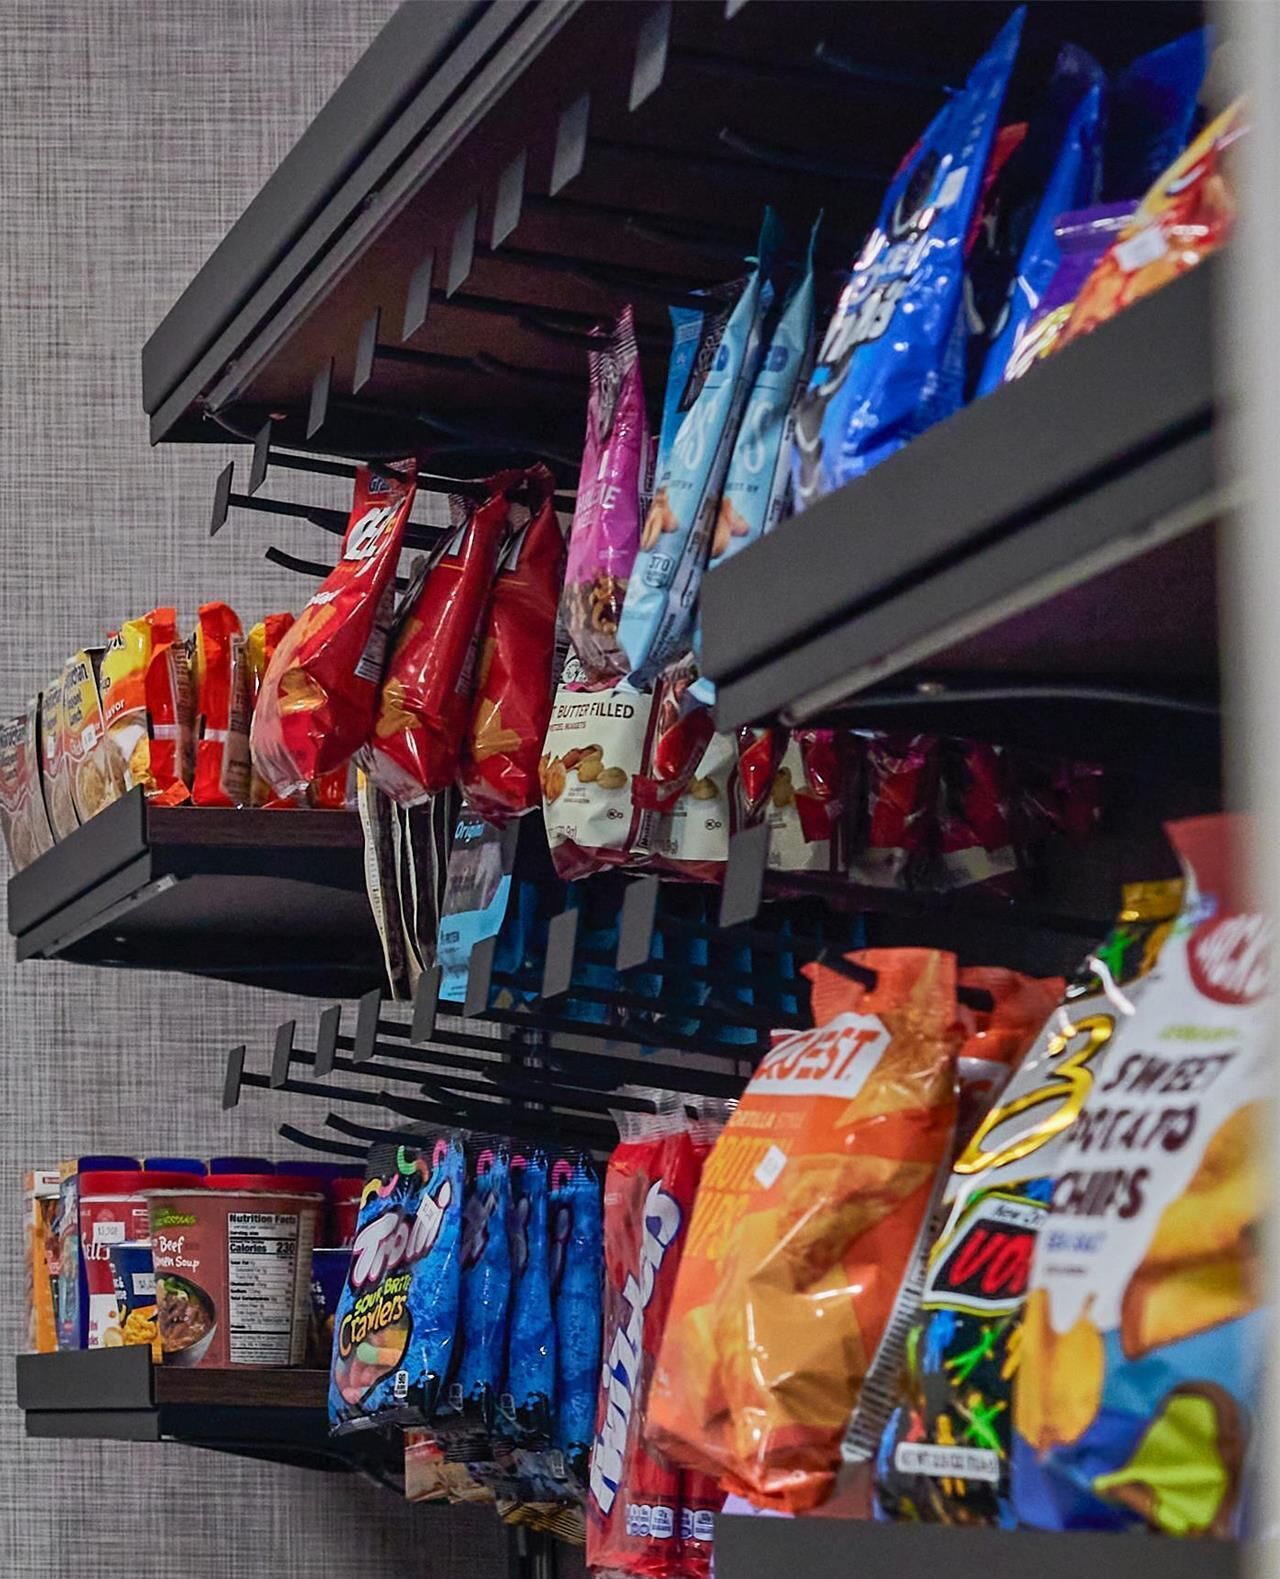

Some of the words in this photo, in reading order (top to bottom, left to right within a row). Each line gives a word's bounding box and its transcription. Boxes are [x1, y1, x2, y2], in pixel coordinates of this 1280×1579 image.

[649, 556, 670, 572] 370
[557, 704, 590, 719] BUTTER
[590, 703, 635, 719] FILLED
[1101, 1053, 1237, 1094] SWEET
[230, 1214, 273, 1224] Nutrition
[274, 1214, 297, 1224] Facts
[159, 1236, 185, 1253] Beef
[230, 1243, 267, 1254] Calories
[176, 1256, 200, 1273] Soup
[355, 1290, 382, 1317] SOUR
[341, 1295, 407, 1358] Crawlers
